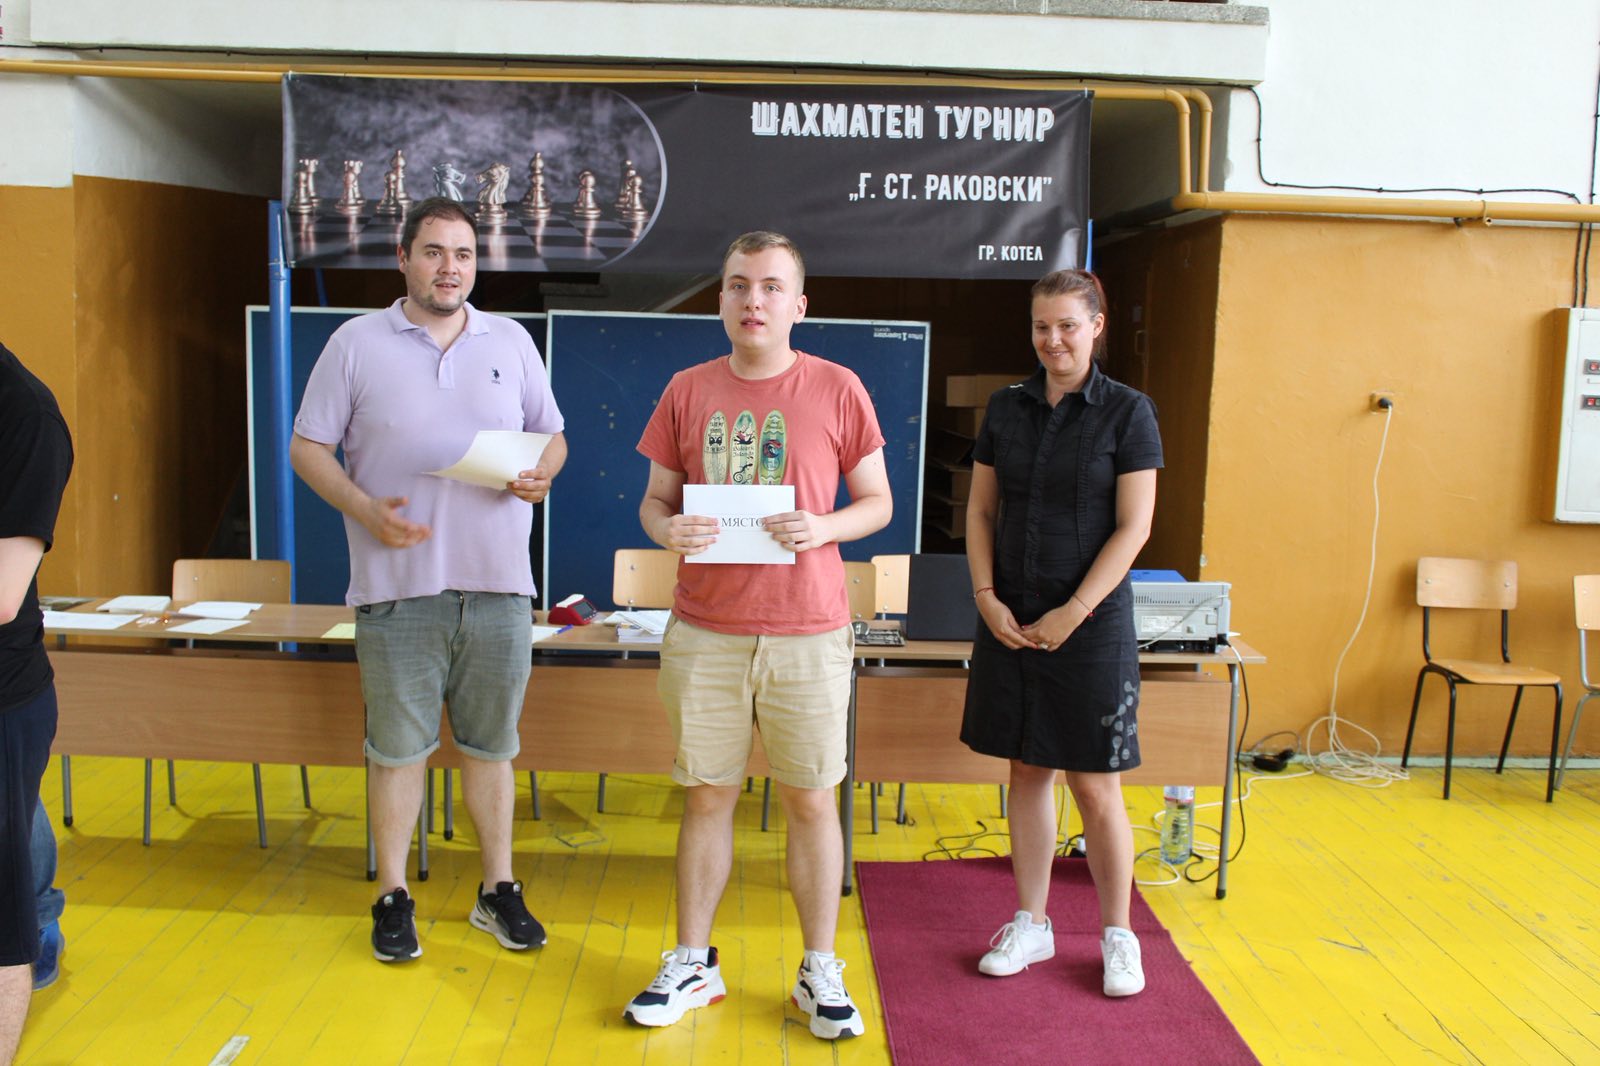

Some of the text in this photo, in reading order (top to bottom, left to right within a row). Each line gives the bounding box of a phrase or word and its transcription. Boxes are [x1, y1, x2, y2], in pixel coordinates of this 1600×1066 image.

[751, 101, 1055, 142] ШАХМАТЕН ТУРНИР
[849, 172, 1053, 202] „Г. СТ. РАКОВСКИ”
[978, 244, 1043, 261] ГР. КОТЕЛ
[721, 517, 765, 528] МЯСТО
